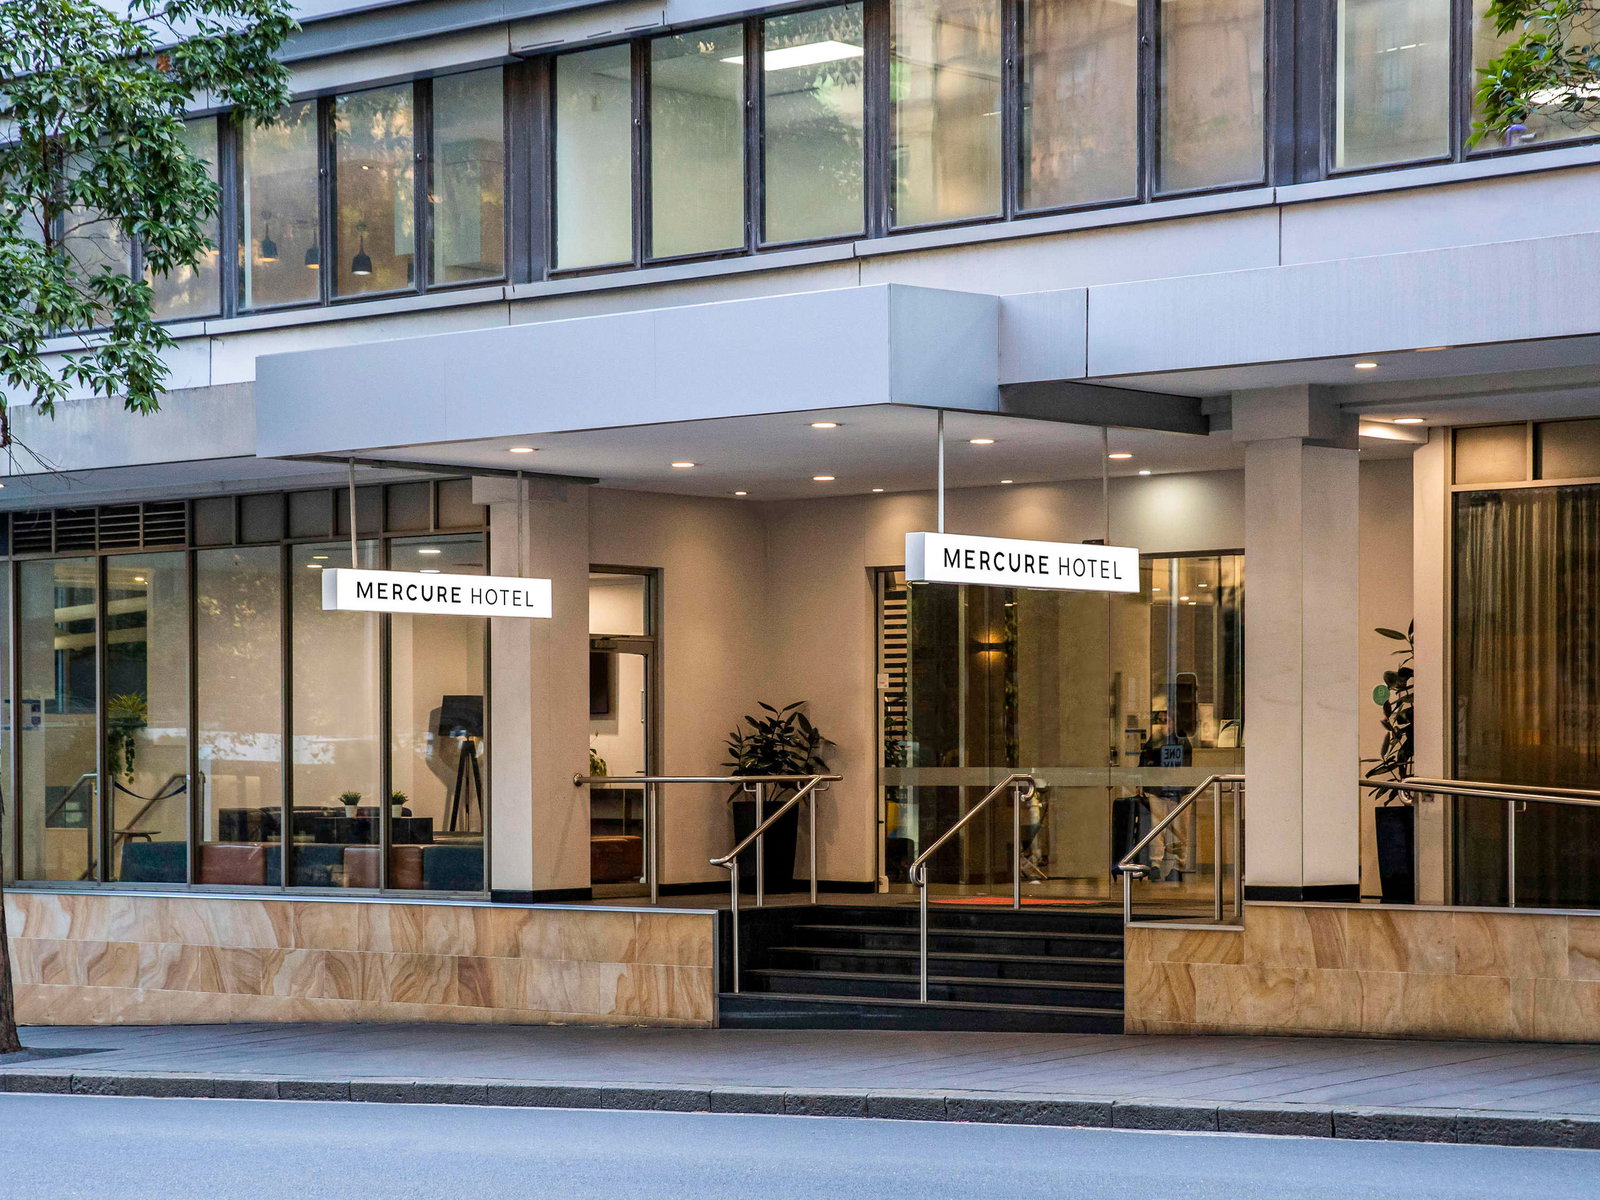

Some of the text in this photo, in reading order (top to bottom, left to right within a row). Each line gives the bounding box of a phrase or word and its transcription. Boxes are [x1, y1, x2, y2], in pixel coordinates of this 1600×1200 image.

[943, 548, 1122, 580] MERCURE HOTEL
[356, 581, 534, 607] MERCURE HOTEL
